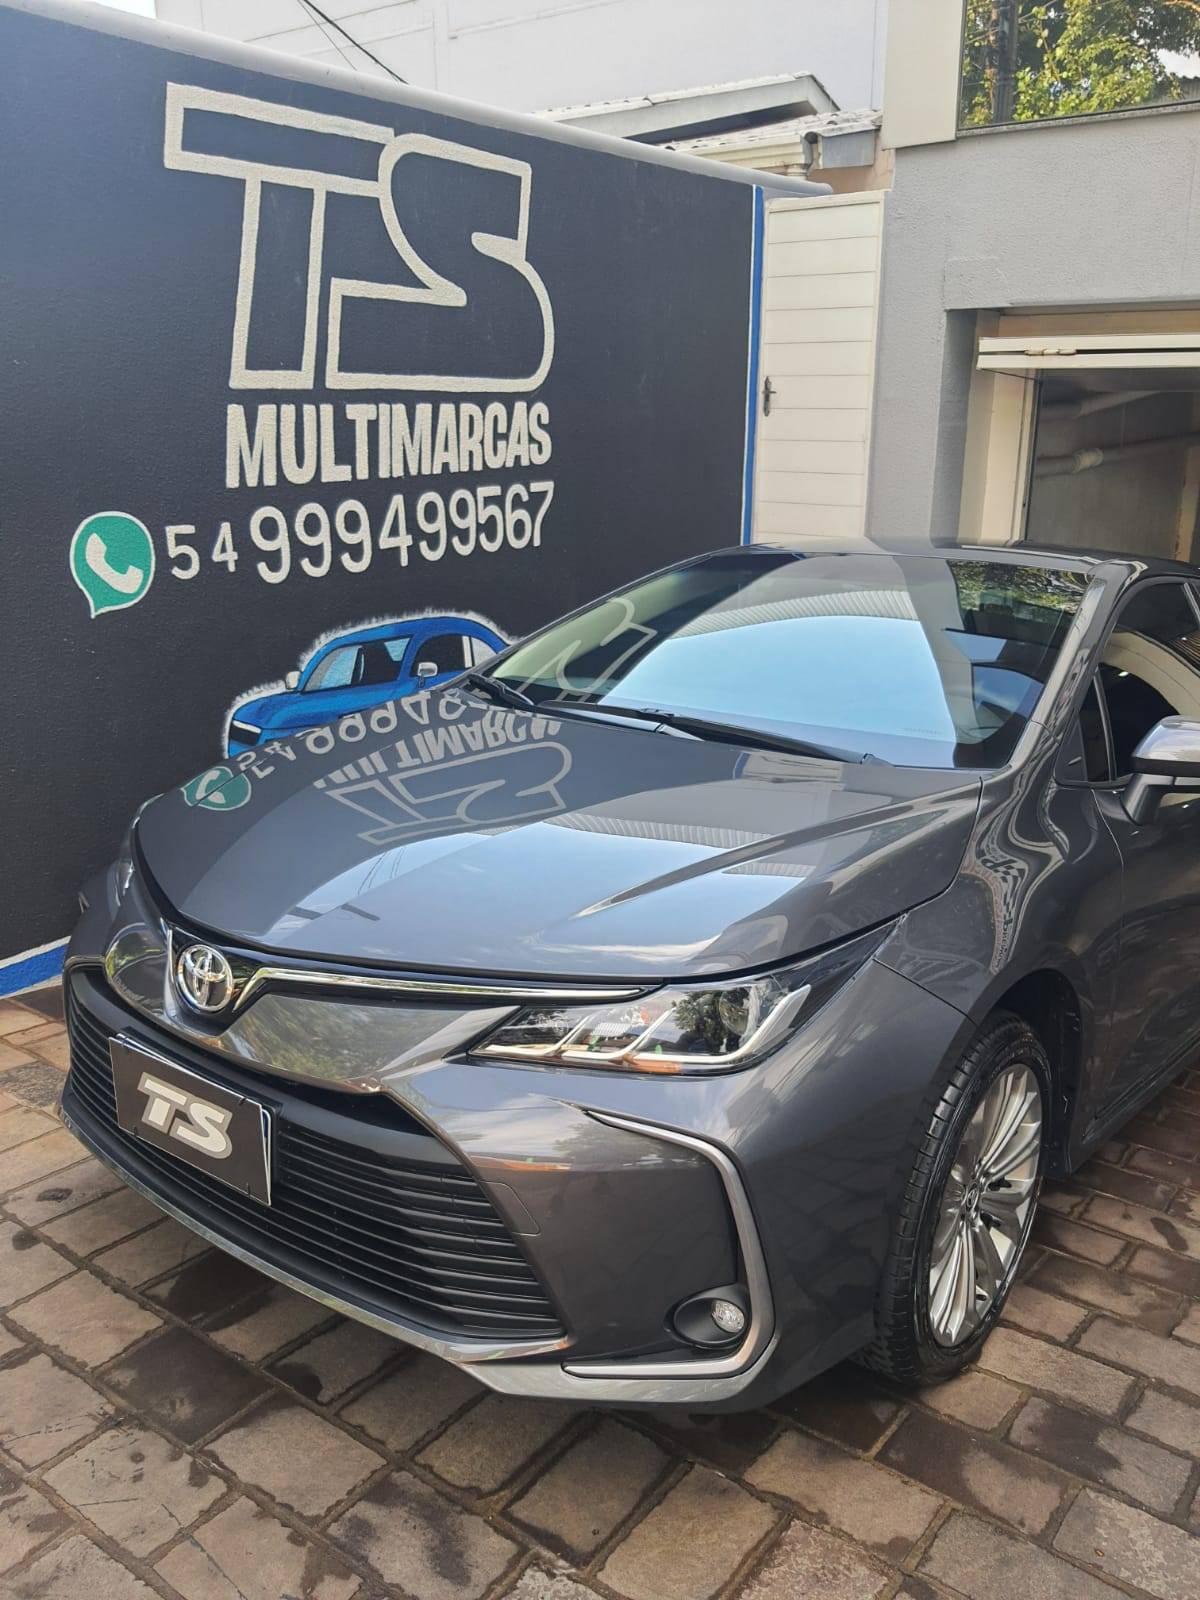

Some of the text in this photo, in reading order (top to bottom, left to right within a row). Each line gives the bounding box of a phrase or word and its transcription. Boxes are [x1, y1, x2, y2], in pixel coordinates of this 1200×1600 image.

[163, 82, 555, 393] TS
[226, 401, 553, 489] MULTIMARCAS
[137, 1071, 233, 1160] TS
